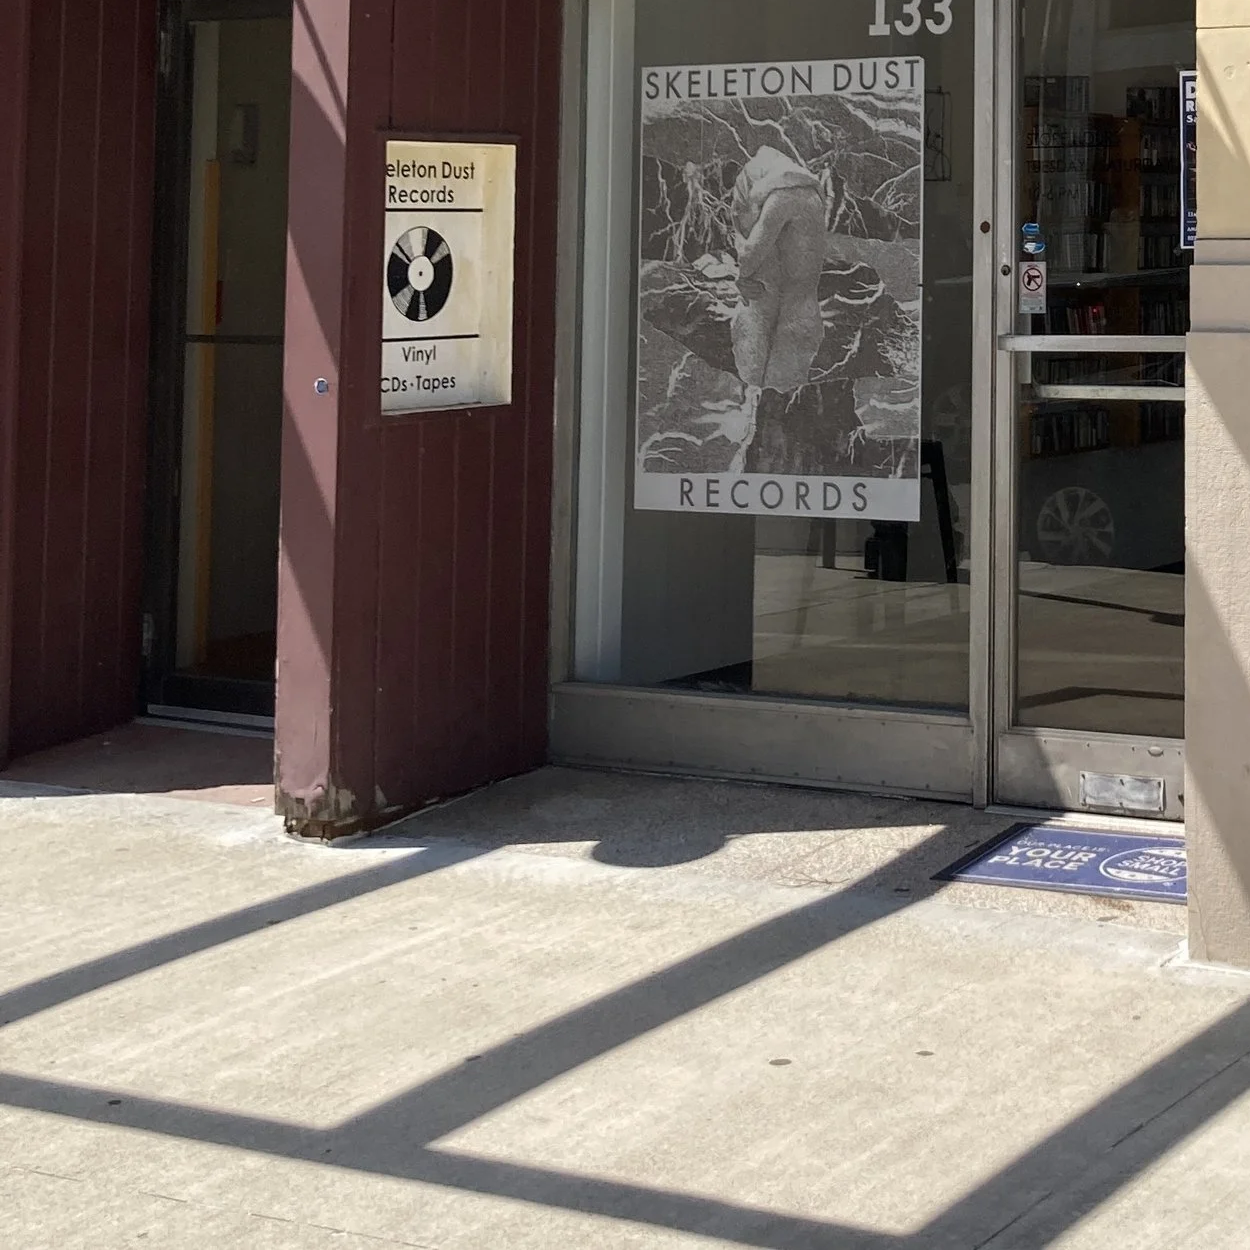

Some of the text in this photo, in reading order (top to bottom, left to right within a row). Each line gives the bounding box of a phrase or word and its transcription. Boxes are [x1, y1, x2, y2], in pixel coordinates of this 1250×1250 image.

[645, 59, 921, 101] SKELETON DUST
[386, 161, 475, 180] eleton Dust
[388, 185, 455, 203] Records
[401, 345, 437, 365] Vinyl
[679, 478, 869, 513] RECORDS
[987, 854, 1085, 871] PLACE
[1008, 845, 1097, 862] YOUR
[1117, 859, 1181, 876] SMALL
